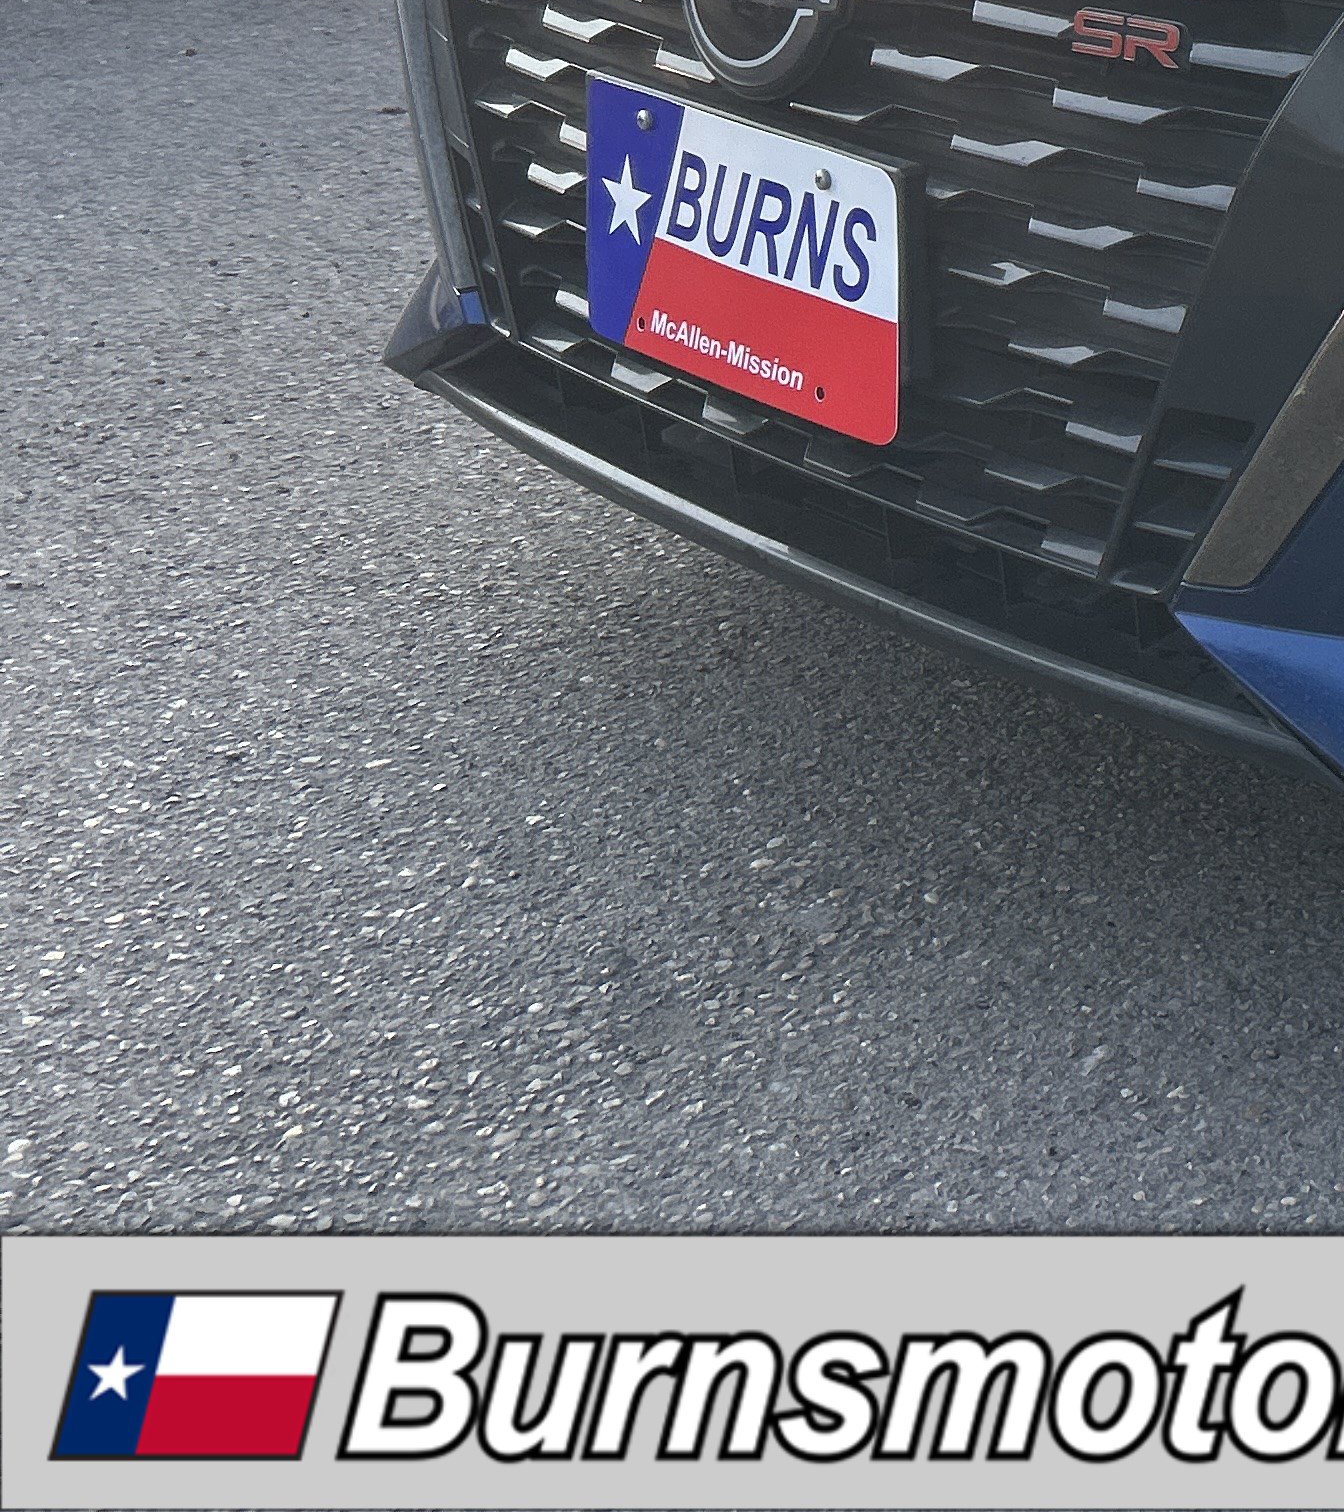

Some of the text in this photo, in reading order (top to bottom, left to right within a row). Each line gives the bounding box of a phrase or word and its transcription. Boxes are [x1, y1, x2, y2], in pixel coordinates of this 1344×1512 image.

[1071, 9, 1181, 69] SR
[666, 150, 877, 303] BURNS
[650, 309, 804, 390] McAllen-Mission
